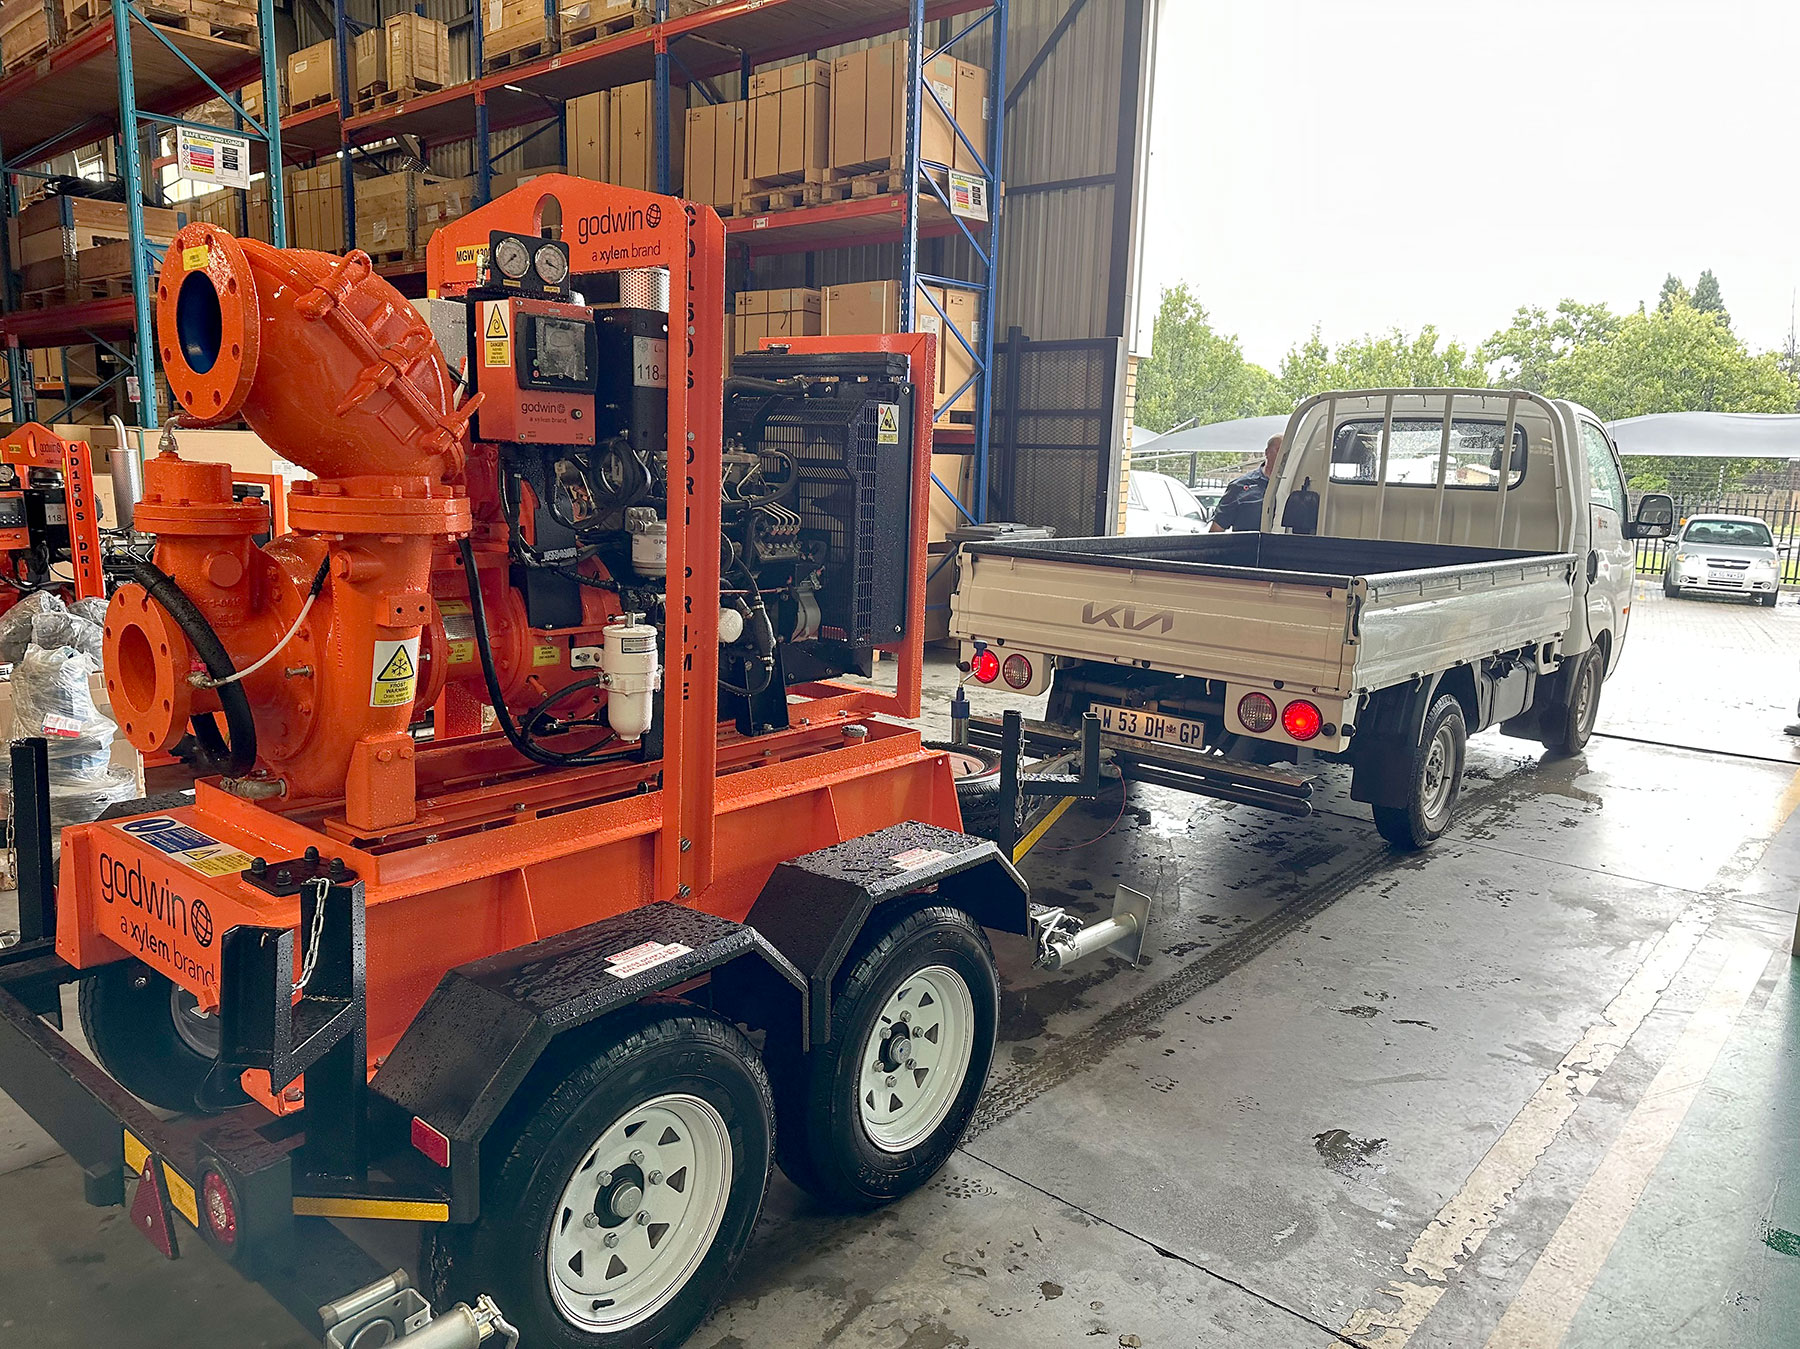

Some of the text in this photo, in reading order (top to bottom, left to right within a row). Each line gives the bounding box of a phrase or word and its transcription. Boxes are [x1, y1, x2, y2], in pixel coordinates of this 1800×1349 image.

[578, 205, 643, 245] godwin
[456, 249, 475, 262] MGW
[591, 240, 661, 264] a xylem brand
[637, 364, 659, 381] 118
[521, 401, 557, 415] godwin
[47, 514, 62, 522] 118
[69, 443, 89, 577] CD150S DRI
[1081, 601, 1175, 634] KIA
[1118, 711, 1138, 733] 53
[1144, 716, 1165, 739] DH
[1179, 722, 1201, 745] GP
[100, 852, 188, 937] godwin
[120, 915, 215, 987] a xylem brand
